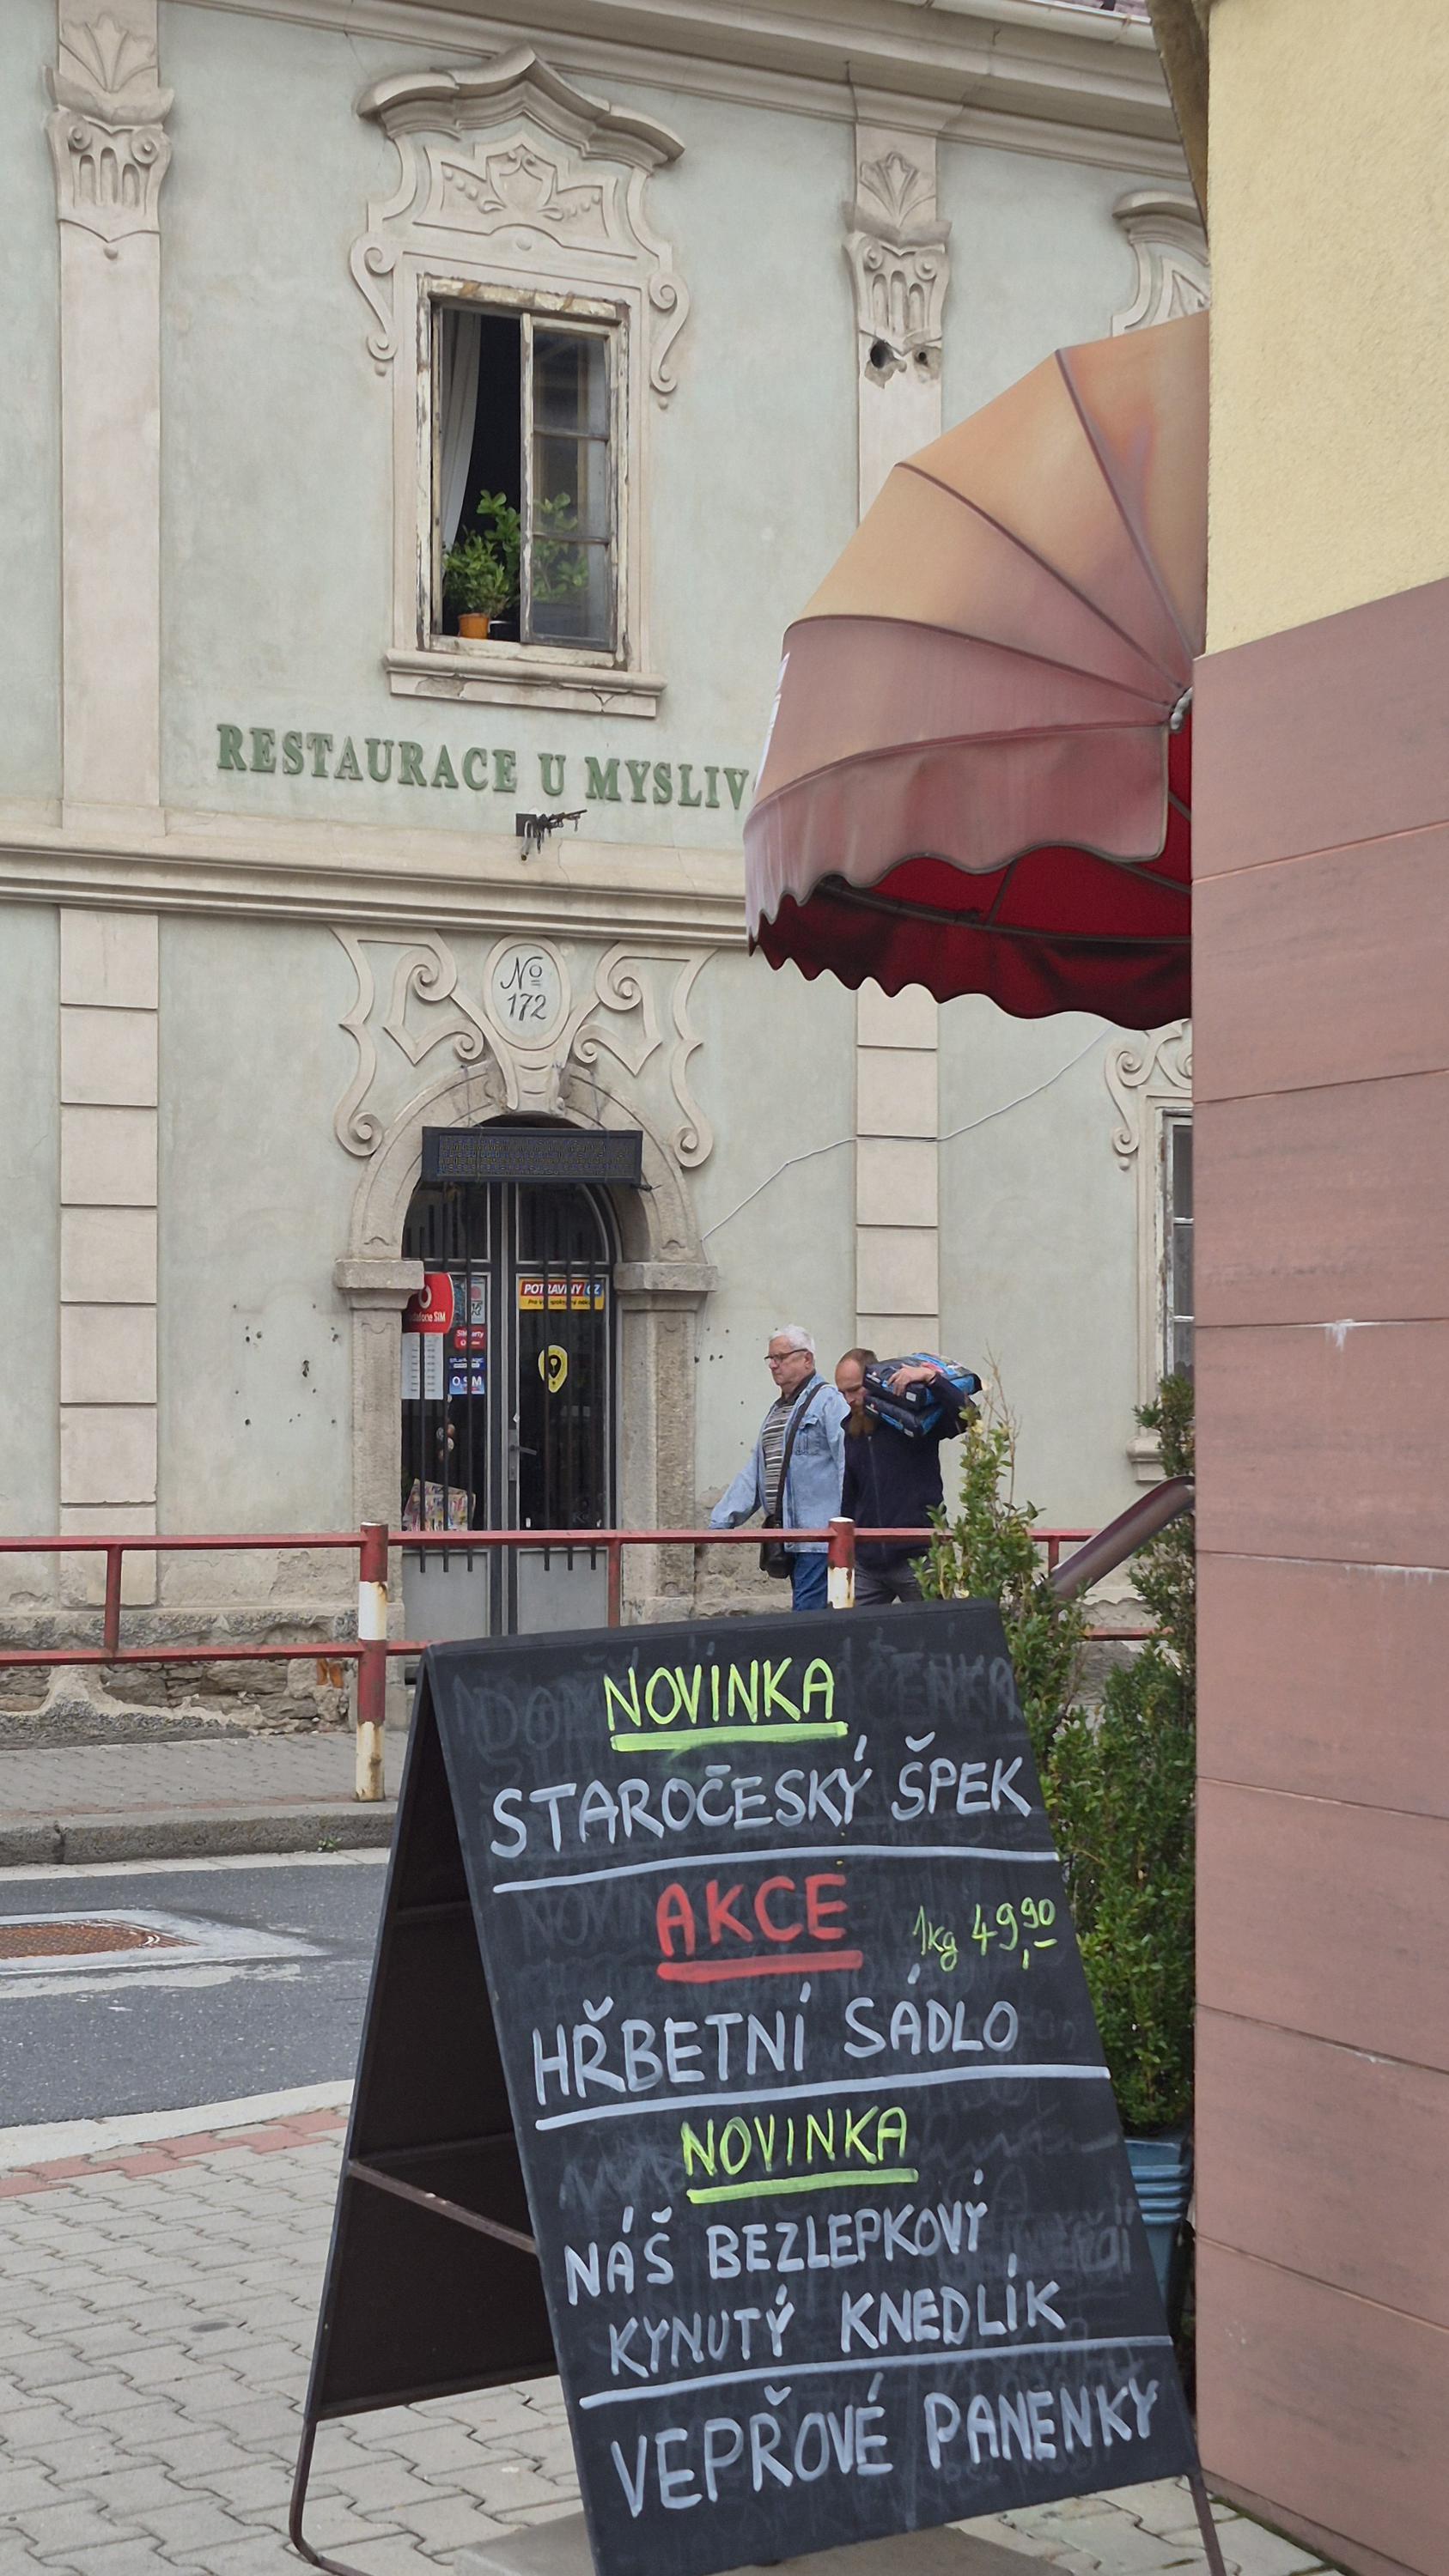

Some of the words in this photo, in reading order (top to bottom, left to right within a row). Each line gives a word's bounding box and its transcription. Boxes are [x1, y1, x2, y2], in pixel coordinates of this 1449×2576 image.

[217, 724, 516, 793] RESTAURACE
[538, 753, 566, 796] U
[586, 756, 757, 810] MYSLIV
[508, 993, 546, 1022] 172
[434, 1310, 446, 1321] SIM
[604, 1656, 836, 1732] NOVINKA
[490, 1734, 874, 1860] STAROČESKÝ
[891, 1731, 1032, 1821] ŠPEK
[656, 1873, 848, 1958] AKCE
[532, 1981, 812, 2107] HŘBETNÍ
[843, 1963, 1020, 2058] SÁDLO
[681, 2105, 908, 2178] NOVINKA
[564, 2205, 674, 2306] NÁŠ
[706, 2169, 989, 2281] BEZLEPKOVÝ
[609, 2284, 795, 2379] KYNUTÝ
[840, 2252, 1068, 2354] KNEDLÍK
[611, 2372, 895, 2518] VEPŘOVÉ
[923, 2378, 1159, 2471] PANENKY
